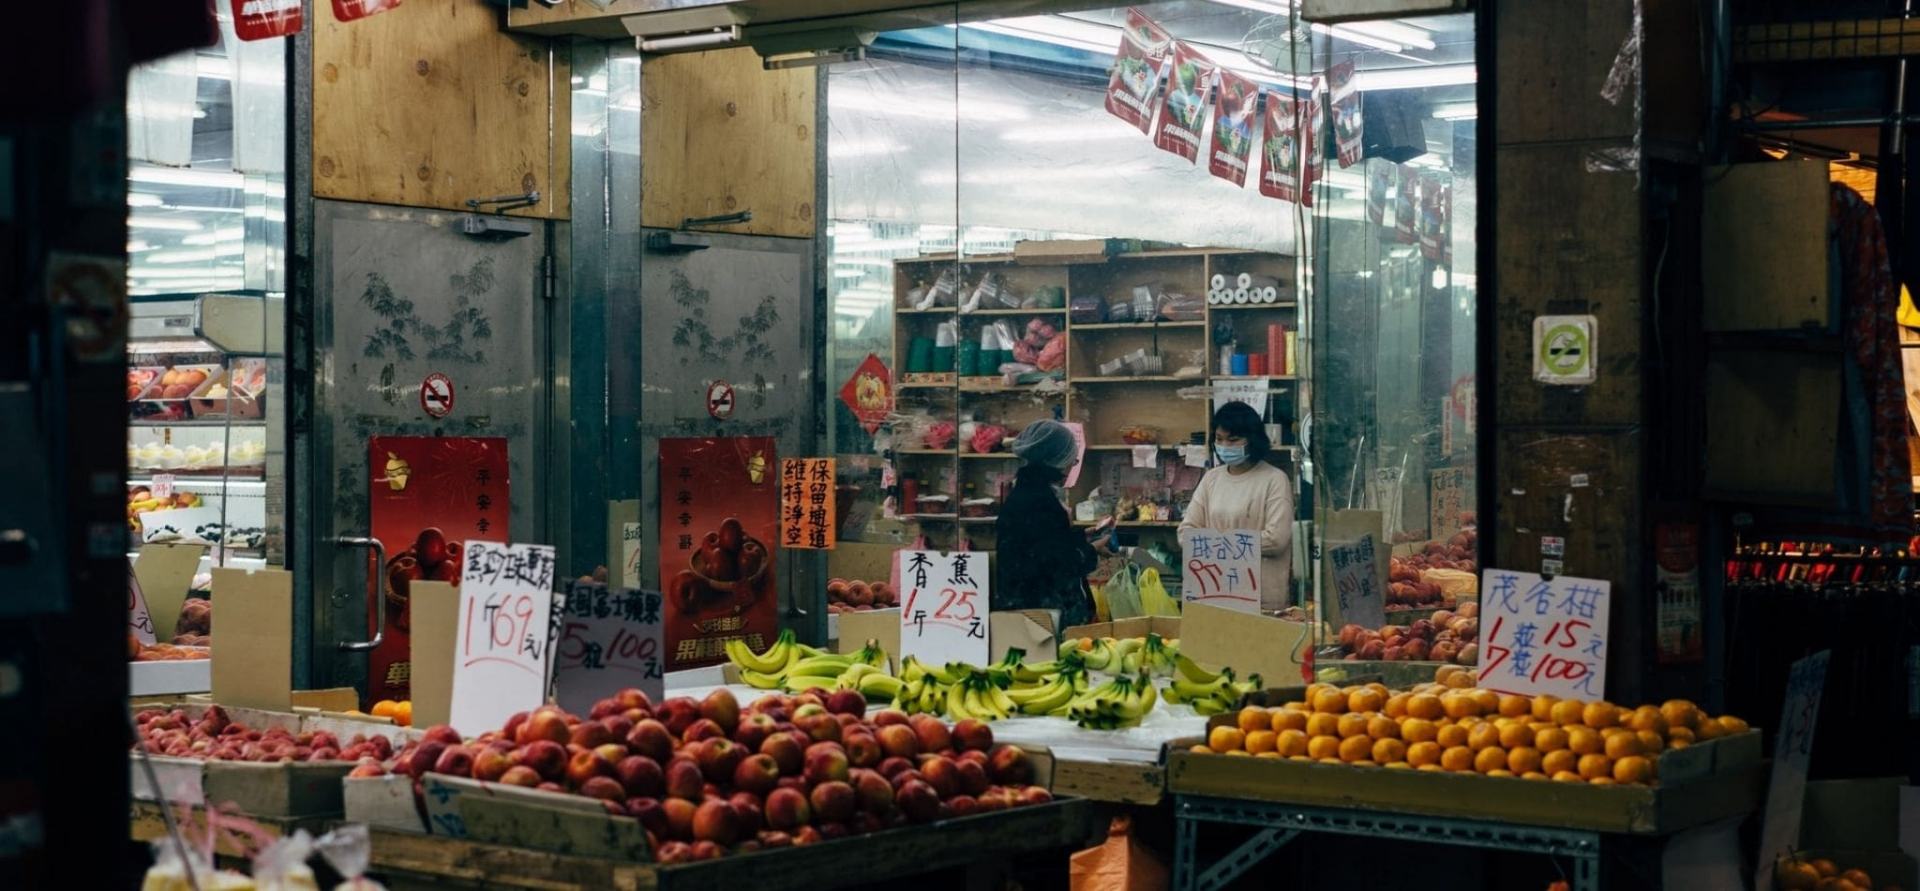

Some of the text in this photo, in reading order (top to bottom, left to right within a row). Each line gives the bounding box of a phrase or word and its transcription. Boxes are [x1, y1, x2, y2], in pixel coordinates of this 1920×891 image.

[784, 460, 806, 545] 維持淨空
[809, 460, 831, 548] 保留通道
[908, 552, 978, 588] 香蕉
